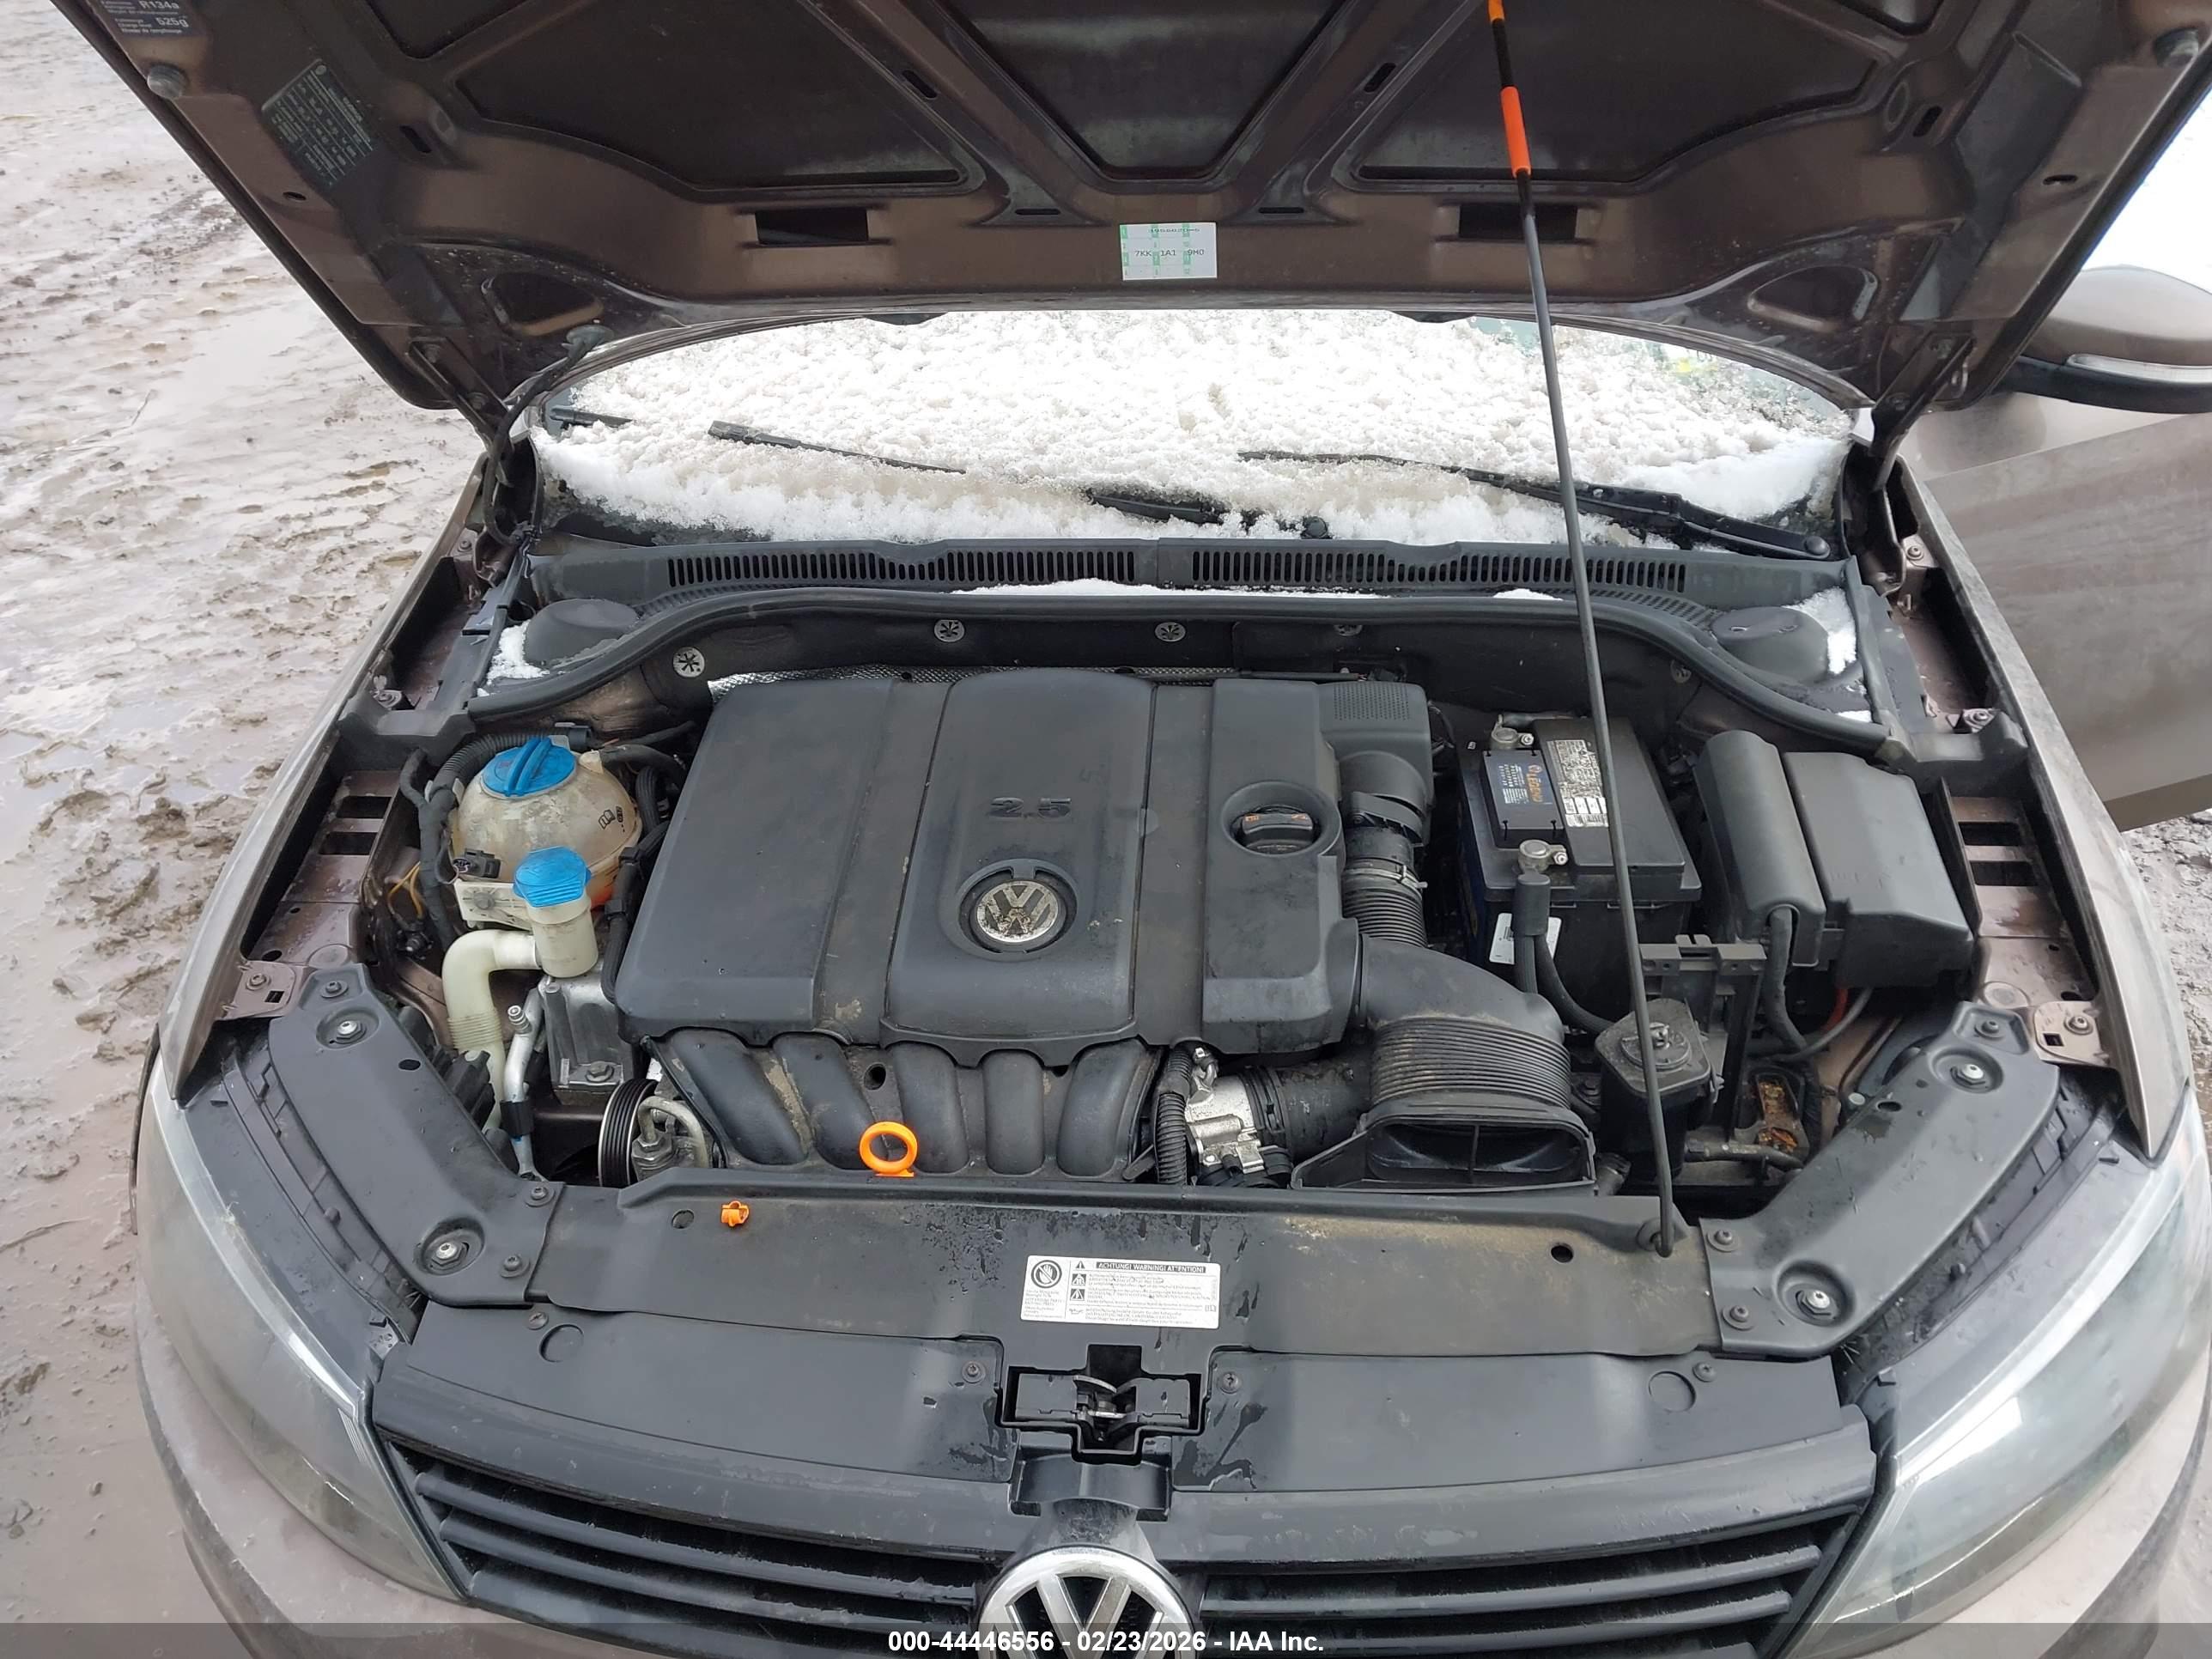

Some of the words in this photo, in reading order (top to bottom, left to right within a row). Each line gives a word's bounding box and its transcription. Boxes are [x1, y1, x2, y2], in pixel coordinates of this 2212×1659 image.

[139, 1, 179, 9] R134a
[988, 796, 1073, 818] 2.5
[977, 880, 1059, 943] VW
[1098, 1262, 1133, 1271] ACHTUNG!
[1133, 1263, 1167, 1272] WARNING!
[1167, 1265, 1205, 1273] ATTENTION!
